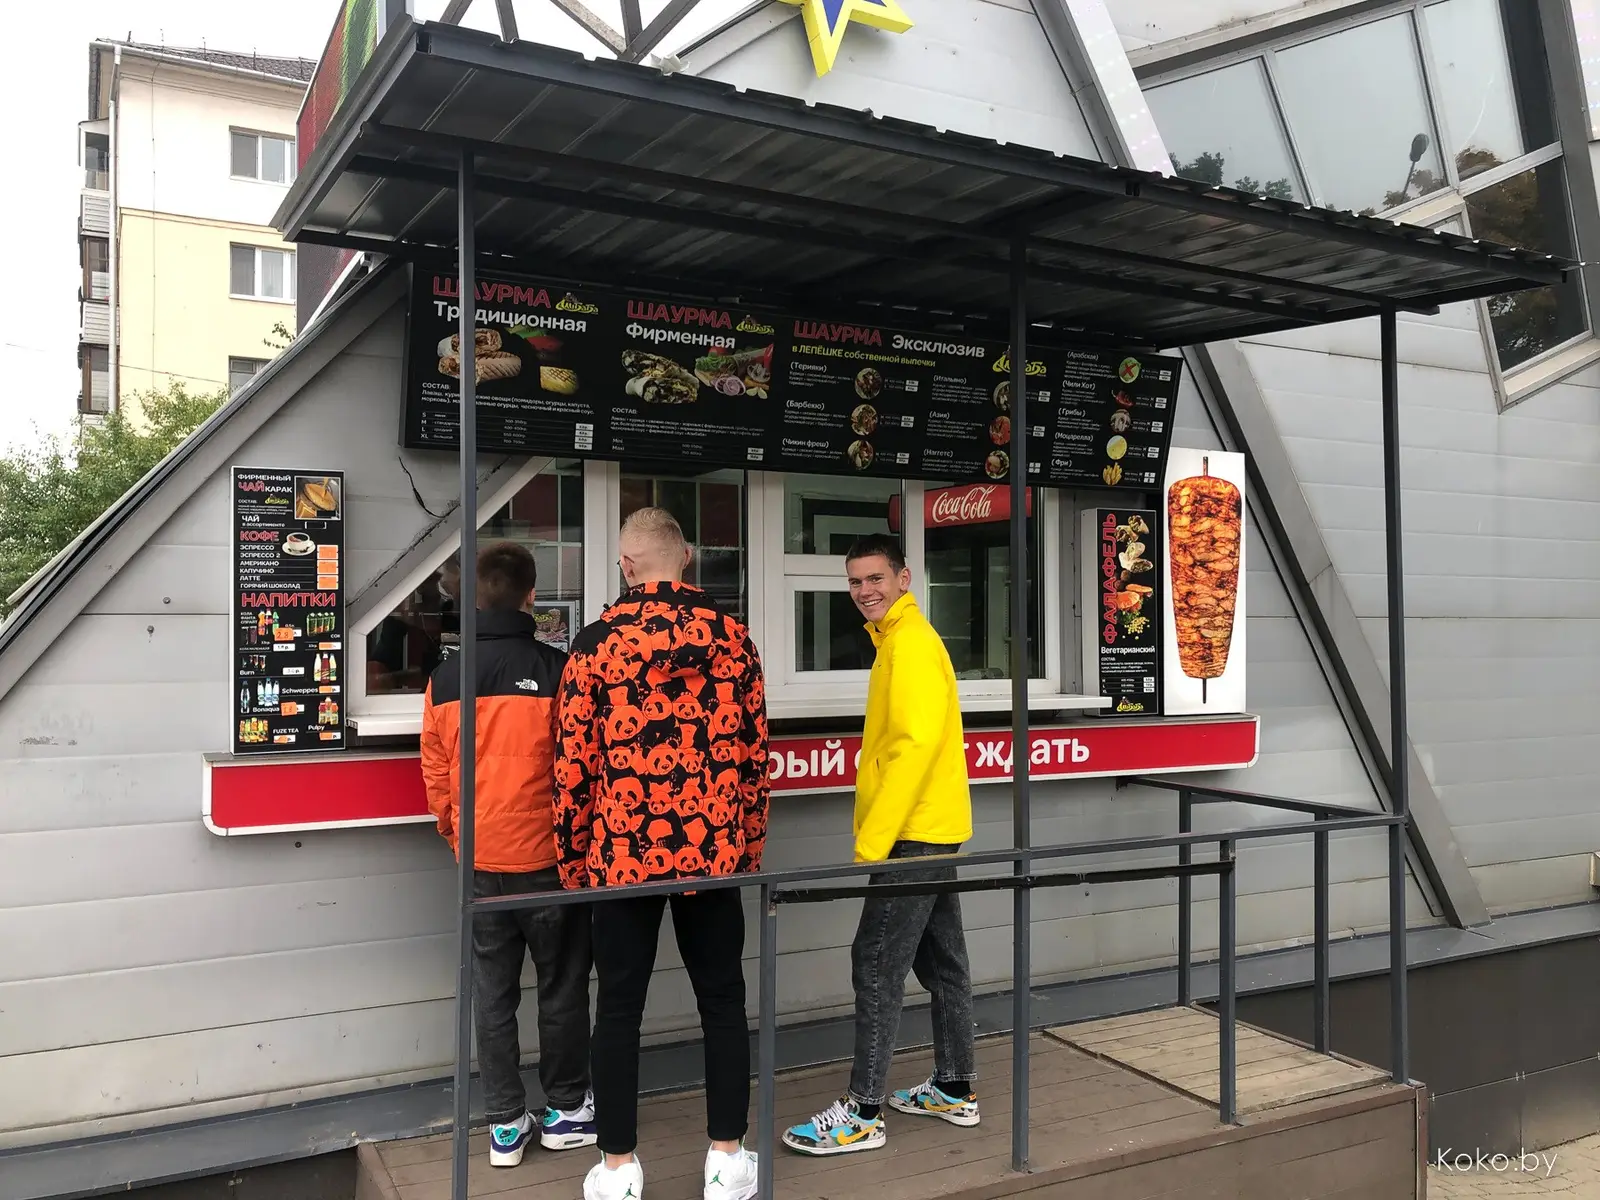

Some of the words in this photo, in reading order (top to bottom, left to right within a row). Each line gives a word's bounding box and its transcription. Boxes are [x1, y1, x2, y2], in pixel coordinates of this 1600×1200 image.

[433, 275, 551, 308] ШУРМА
[433, 300, 587, 332] Трдиционная
[627, 300, 732, 329] ШАУРМА
[626, 322, 736, 349] Фирменная
[794, 320, 882, 346] ШАУРМА
[892, 335, 985, 358] Эксклюзив
[799, 344, 843, 358] ЛЕПЁШКЕ
[844, 349, 900, 364] собственной
[237, 473, 291, 481] ФИРМЕННЫЙ
[238, 480, 265, 492] ЧАЙ
[241, 514, 260, 522] ЧАЙ
[240, 531, 279, 541] КОФЕ
[1102, 513, 1118, 644] ФАЛАФЕЛЬ
[241, 592, 336, 607] НАПИТКИ
[1101, 645, 1155, 655] Вегетарианский
